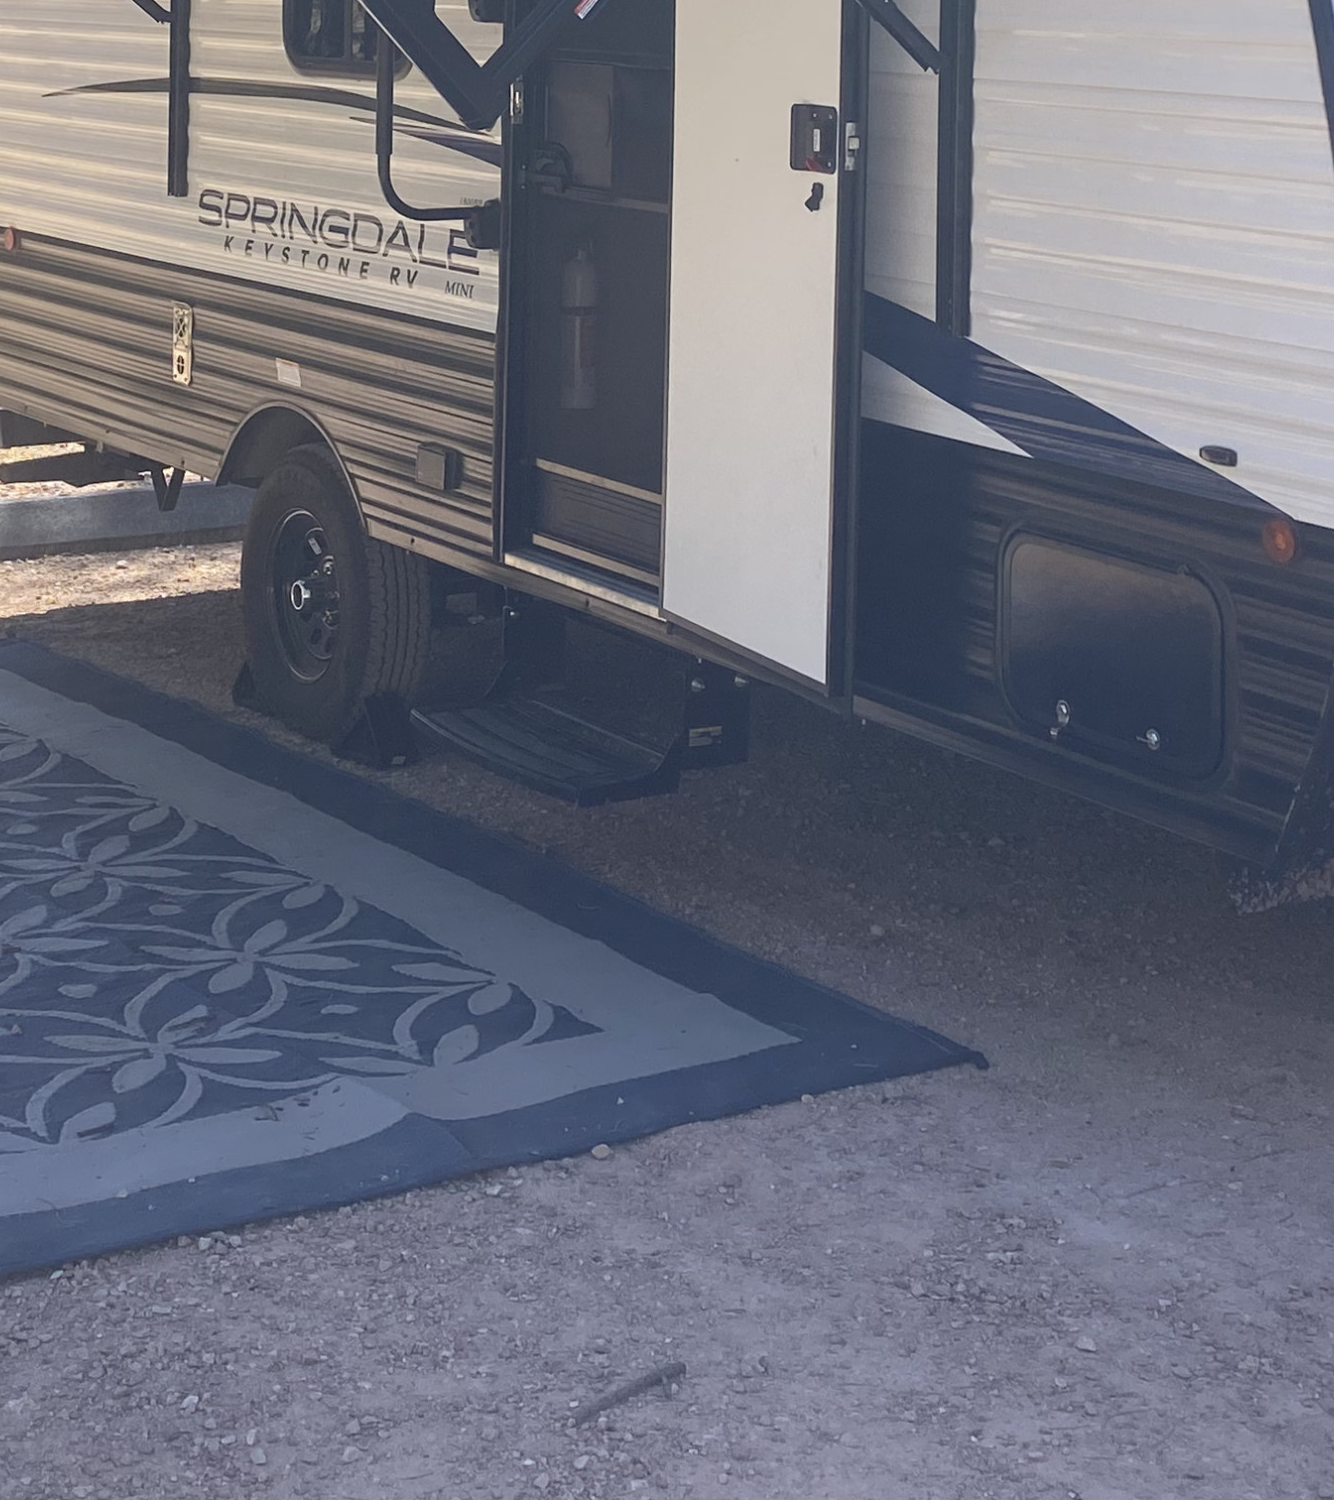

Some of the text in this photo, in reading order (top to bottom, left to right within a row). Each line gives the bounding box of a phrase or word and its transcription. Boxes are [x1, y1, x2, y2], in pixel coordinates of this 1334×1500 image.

[198, 188, 480, 276] SPRINGDALE
[224, 235, 419, 289] KEYSTONE RV
[444, 280, 475, 299] MINI
